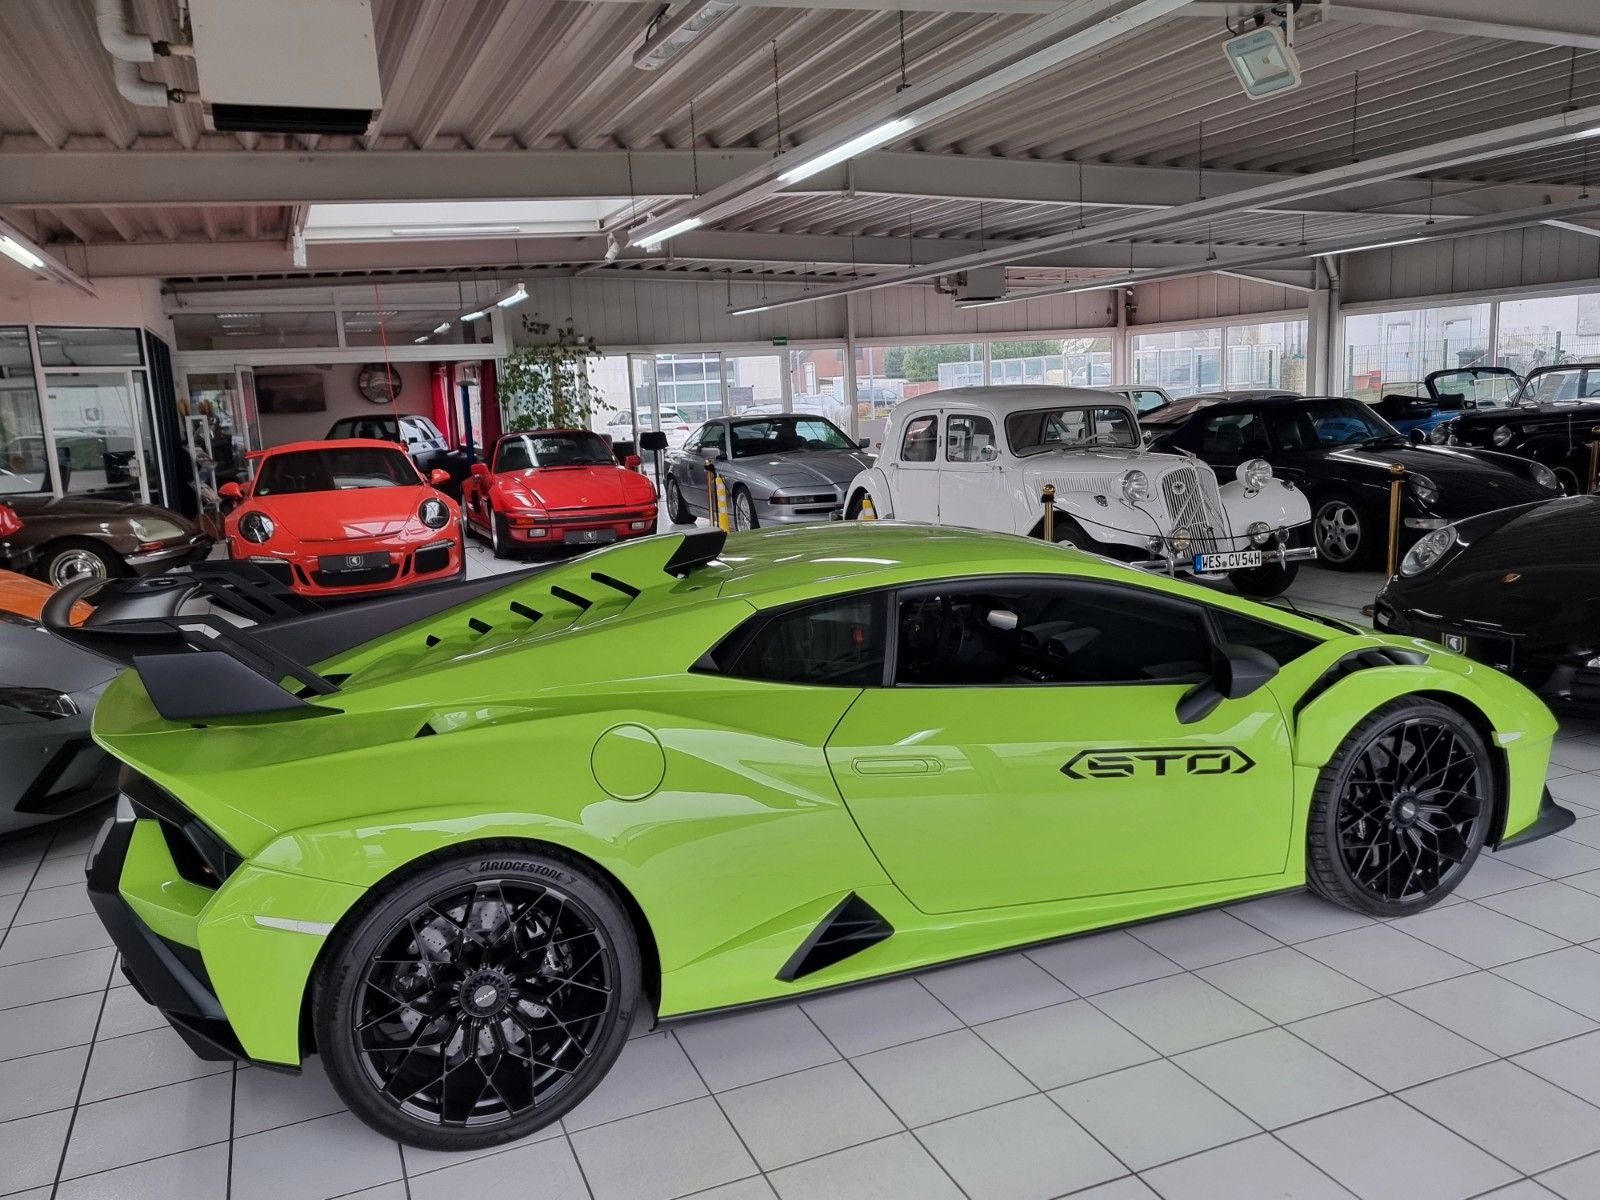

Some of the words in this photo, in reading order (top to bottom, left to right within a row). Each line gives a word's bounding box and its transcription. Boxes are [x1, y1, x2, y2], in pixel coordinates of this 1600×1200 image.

[1202, 555, 1221, 569] WES
[1087, 753, 1231, 779] STO
[480, 860, 565, 881] BRIDGESTONE
